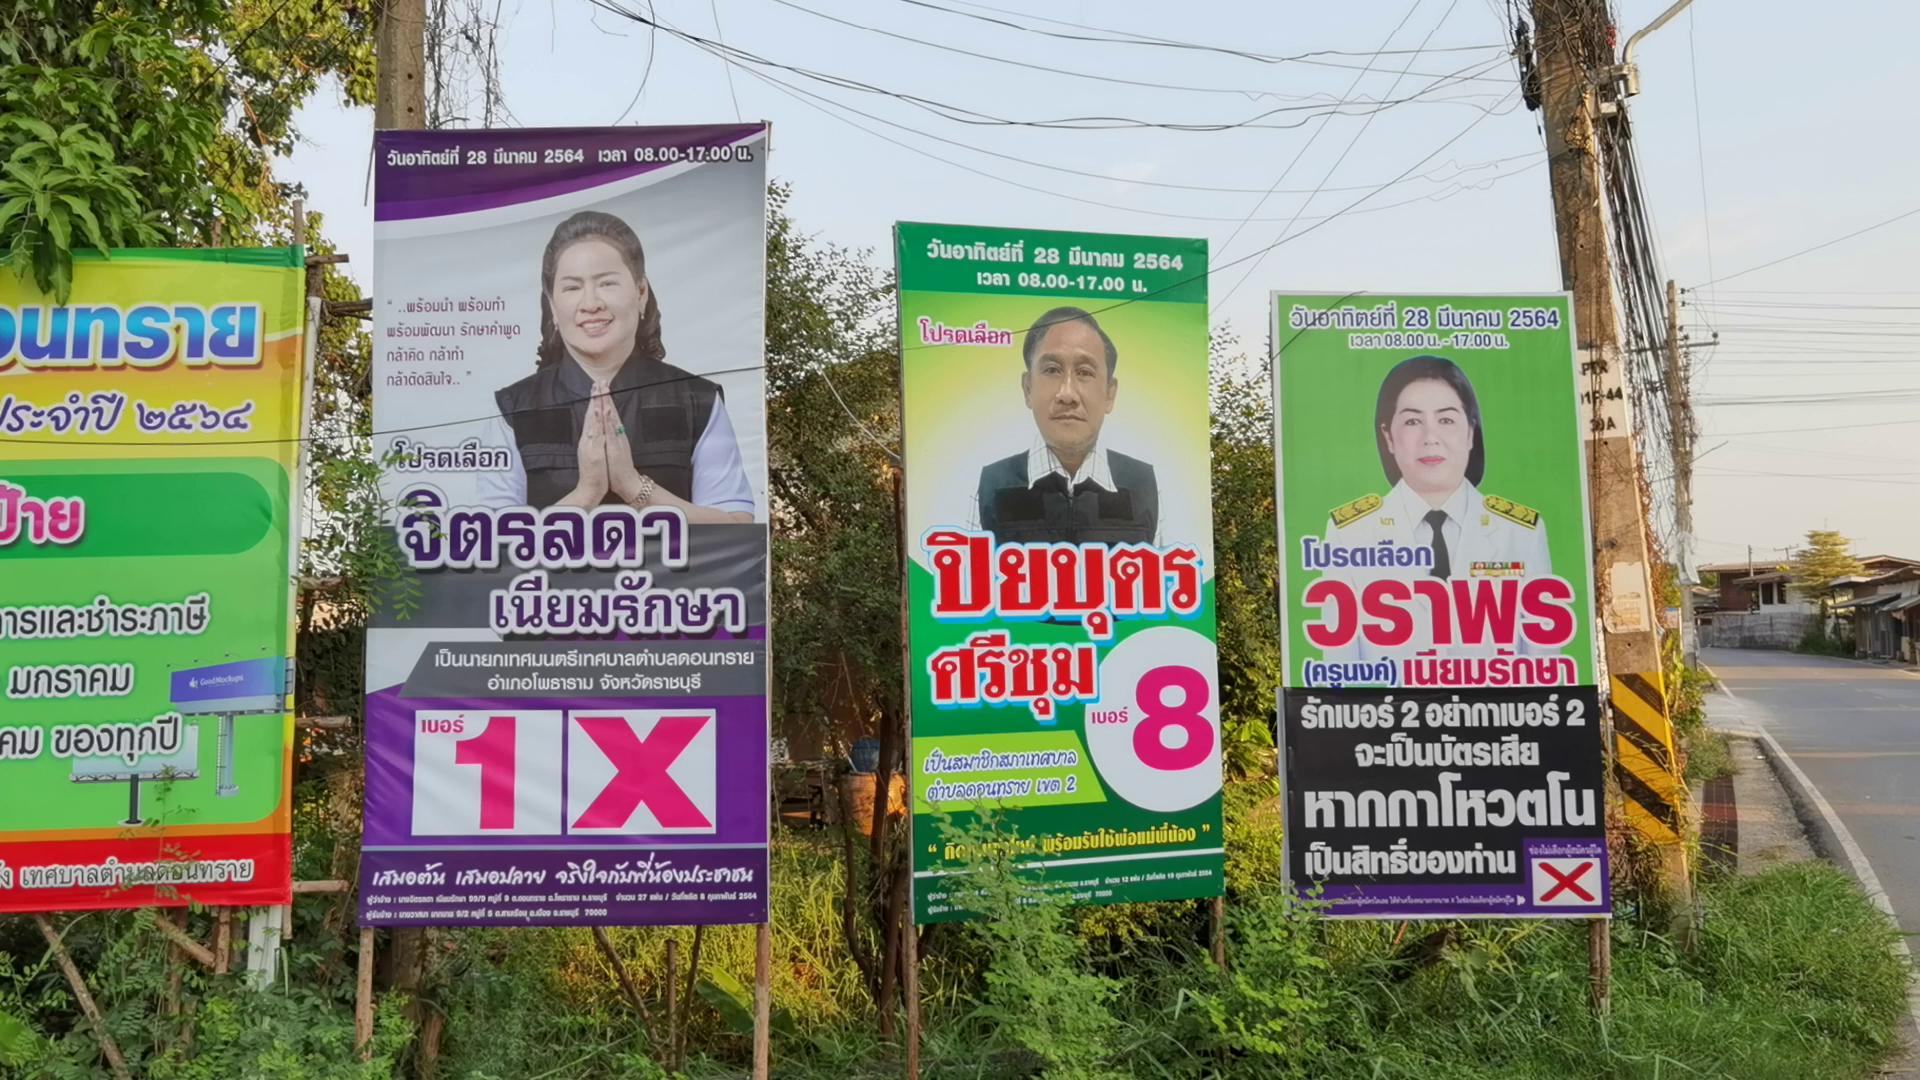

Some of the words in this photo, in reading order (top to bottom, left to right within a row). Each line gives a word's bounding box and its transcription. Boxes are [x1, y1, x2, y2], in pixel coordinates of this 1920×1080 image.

[387, 146, 459, 166] วันอาทิตย์ที่
[467, 149, 487, 165] 28
[493, 147, 537, 165] มีนาคม
[544, 149, 584, 163] 2564
[598, 149, 627, 163] เวลา
[737, 146, 752, 161] น.
[927, 239, 1024, 263] วันอาทิตย์ที่
[1034, 248, 1060, 264] 28
[1069, 246, 1124, 268] มีนาคม
[1134, 252, 1183, 271] 2564
[977, 272, 1010, 286] เวลา
[1018, 273, 1125, 291] 08.00-17.00
[1132, 279, 1148, 293] น.
[458, 296, 505, 312] พร้อมทำ
[1291, 303, 1395, 327] วันอาทิตย์ที่
[1405, 310, 1428, 327] 28
[1438, 308, 1500, 327] มีนาคม
[1510, 310, 1559, 327] 2564
[387, 322, 455, 338] พร้อมพัฒนา
[460, 320, 521, 339] รักษาคำพูด
[920, 319, 1011, 344] โปรดเลือก
[1351, 335, 1381, 347] เวลา
[387, 346, 424, 362] กล้าคิด
[429, 345, 464, 361] กล้าทำ
[137, 402, 251, 431] ๒๕๖๔
[395, 440, 509, 469] โปรดเลือก
[402, 488, 682, 563] จิตรลดา
[1302, 538, 1432, 569] โปรดเลือก
[925, 530, 1198, 636] ปิยบุตร
[0, 598, 207, 634] ารและชำระภาษี
[495, 575, 740, 629] เนียมรักษา
[1304, 578, 1575, 648] วราพร
[434, 648, 755, 669] เป็นนายกเทศมนตรีเทศบาลตำบลดอนทราย
[1403, 650, 1576, 686] เนียมรักษา
[10, 668, 131, 695] มกราคม
[487, 672, 593, 691] อำเภอโพธาราม
[600, 671, 702, 694] จังหวัดราชบุรี
[930, 633, 1095, 716] ศรีชุม
[421, 713, 466, 733] เบอร์
[1091, 706, 1129, 724] เบอร์
[1132, 665, 1215, 771] 8
[1300, 695, 1395, 729] รักเบอร์
[1401, 701, 1420, 728] 2
[1425, 694, 1560, 727] อย่ากาเบอร์
[1566, 699, 1585, 726] 2
[55, 717, 179, 762] ของทุกปี
[1354, 732, 1540, 768] จะเป็นบัตรเสีย
[455, 716, 516, 829] 1
[925, 749, 1077, 772] เป็นสมาชิกสภาเทศบาล
[927, 779, 1031, 801] ตำบลดอนทราย
[1037, 779, 1061, 793] เขต
[1066, 776, 1076, 791] 2
[1304, 771, 1597, 828] หากกาโหวตโน
[372, 862, 446, 886] เสมอต้น
[456, 868, 546, 885] เสมอปลาย
[555, 852, 754, 885] จริงใจกับพี่น้องประชาชน
[1304, 838, 1517, 875] เป็นสิทธิ์ของท่าน
